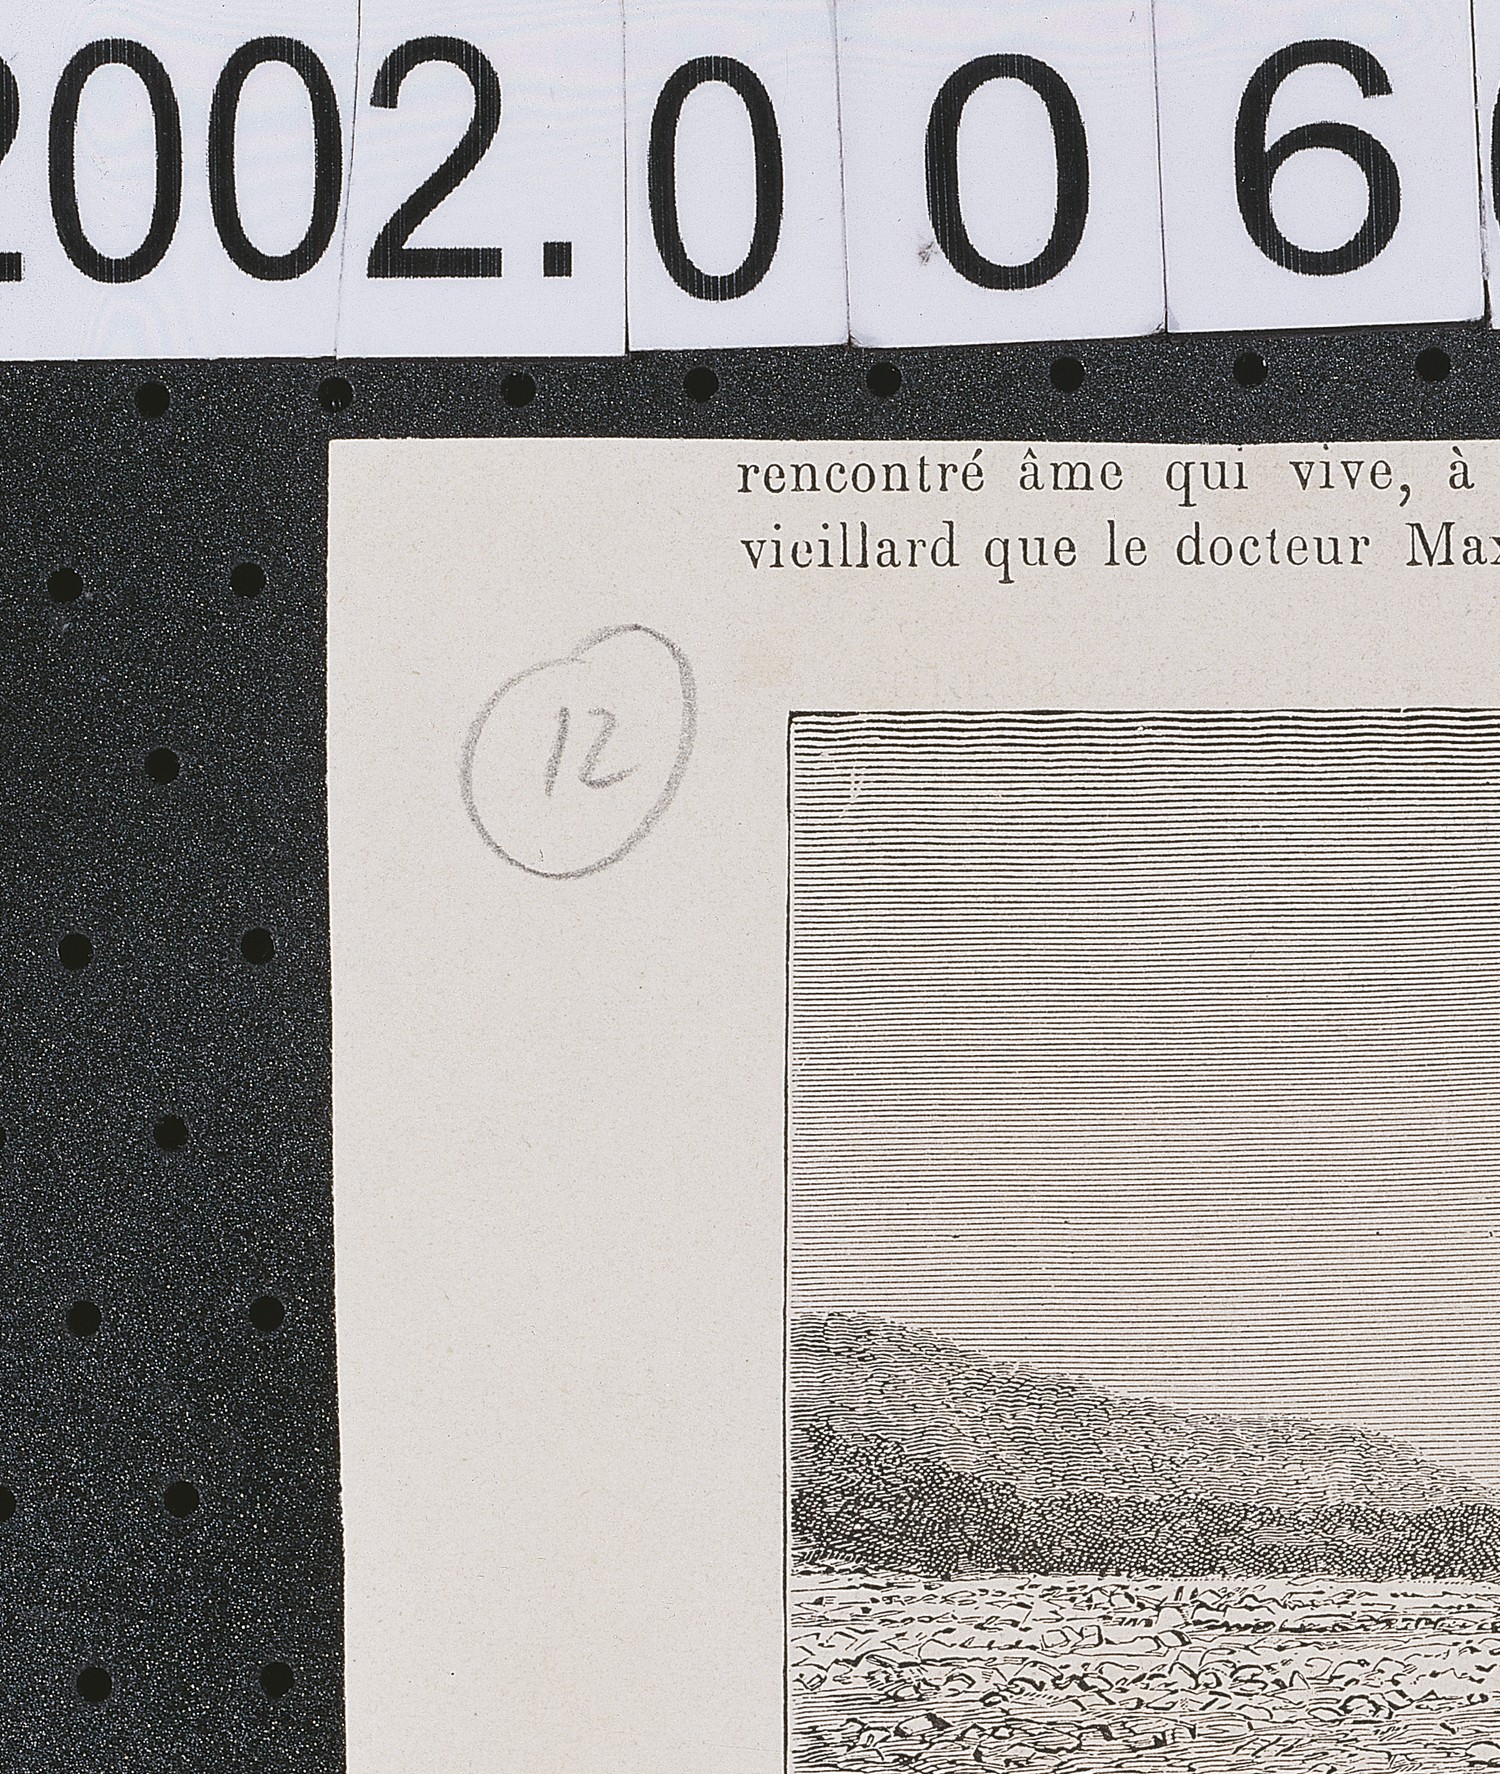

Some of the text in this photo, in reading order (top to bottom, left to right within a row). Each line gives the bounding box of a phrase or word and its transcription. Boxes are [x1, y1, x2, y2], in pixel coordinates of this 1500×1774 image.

[737, 448, 985, 494] rencontré
[1019, 447, 1123, 491] âme
[1165, 447, 1249, 508] qui
[1288, 443, 1411, 508] vive,
[1449, 445, 1475, 490] à
[740, 520, 960, 569] vieillard
[984, 536, 1077, 585] que
[1104, 519, 1147, 567] le
[1176, 521, 1370, 567] docteur
[545, 705, 641, 797] 12
